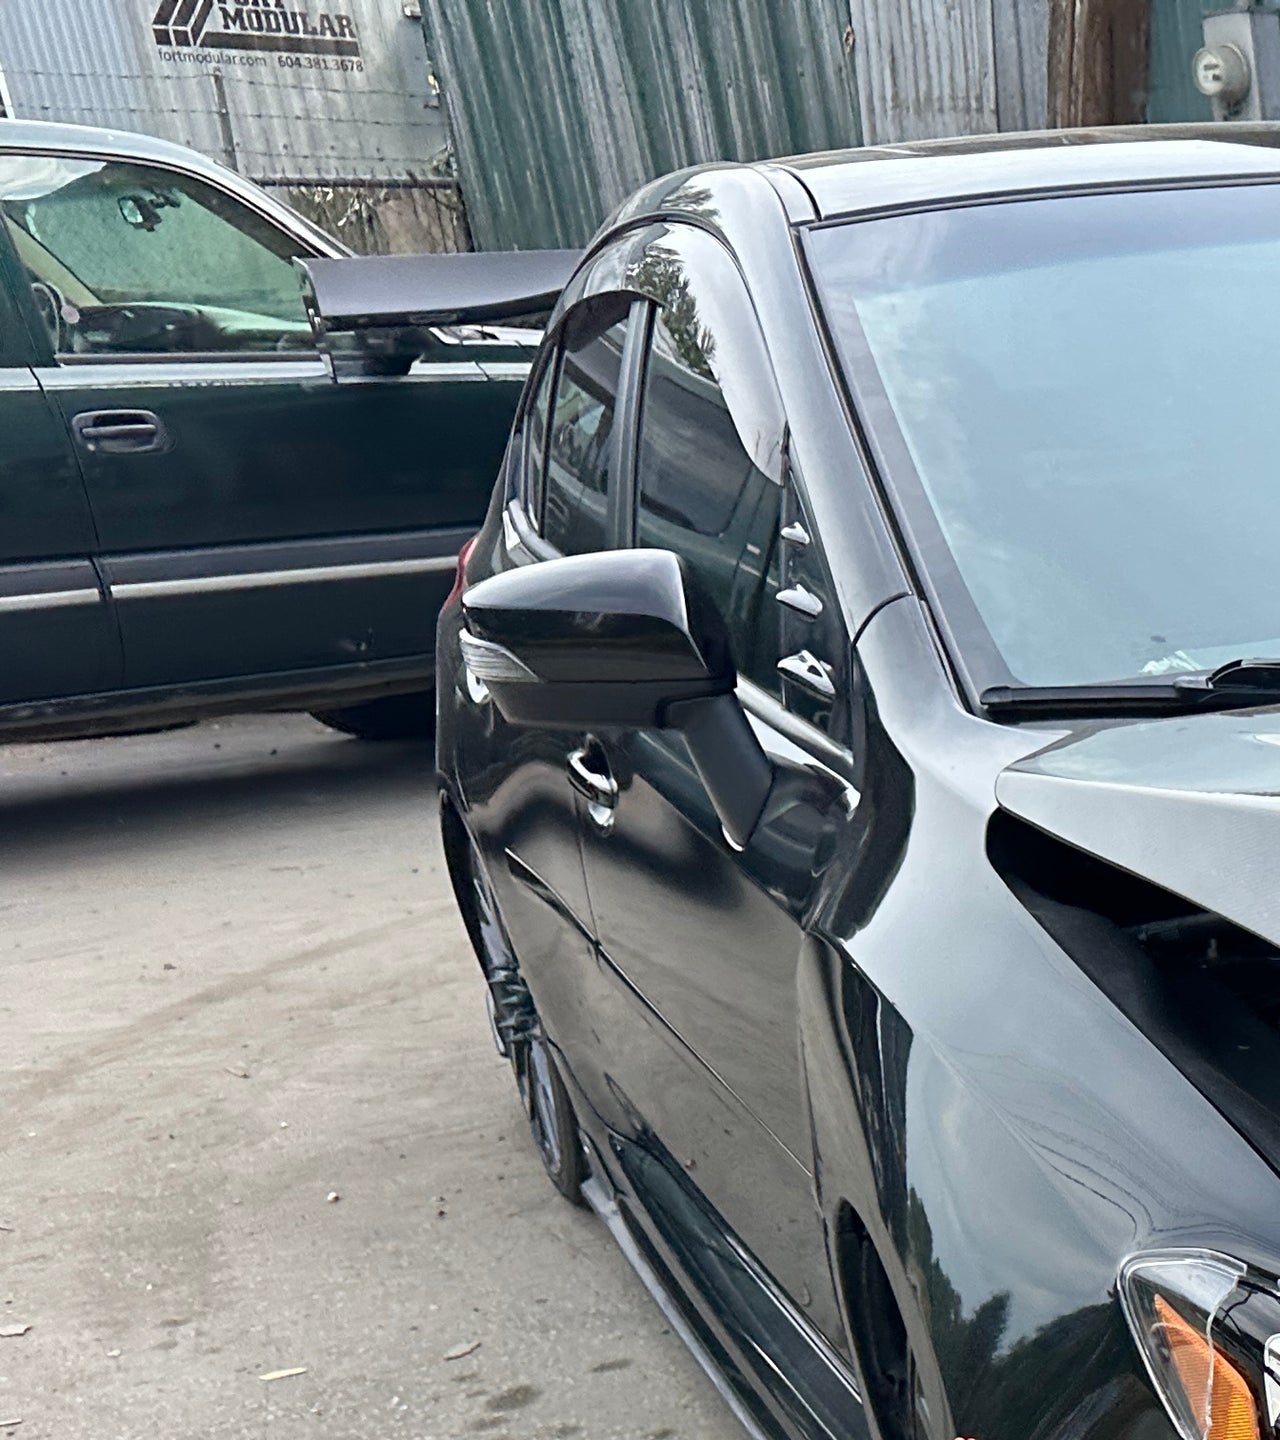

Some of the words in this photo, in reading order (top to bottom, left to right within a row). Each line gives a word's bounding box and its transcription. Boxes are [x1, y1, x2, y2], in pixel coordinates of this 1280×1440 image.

[217, 7, 356, 38] MODULAR
[158, 49, 267, 67] fortmodular.com
[278, 56, 364, 72] 604.381.3678
